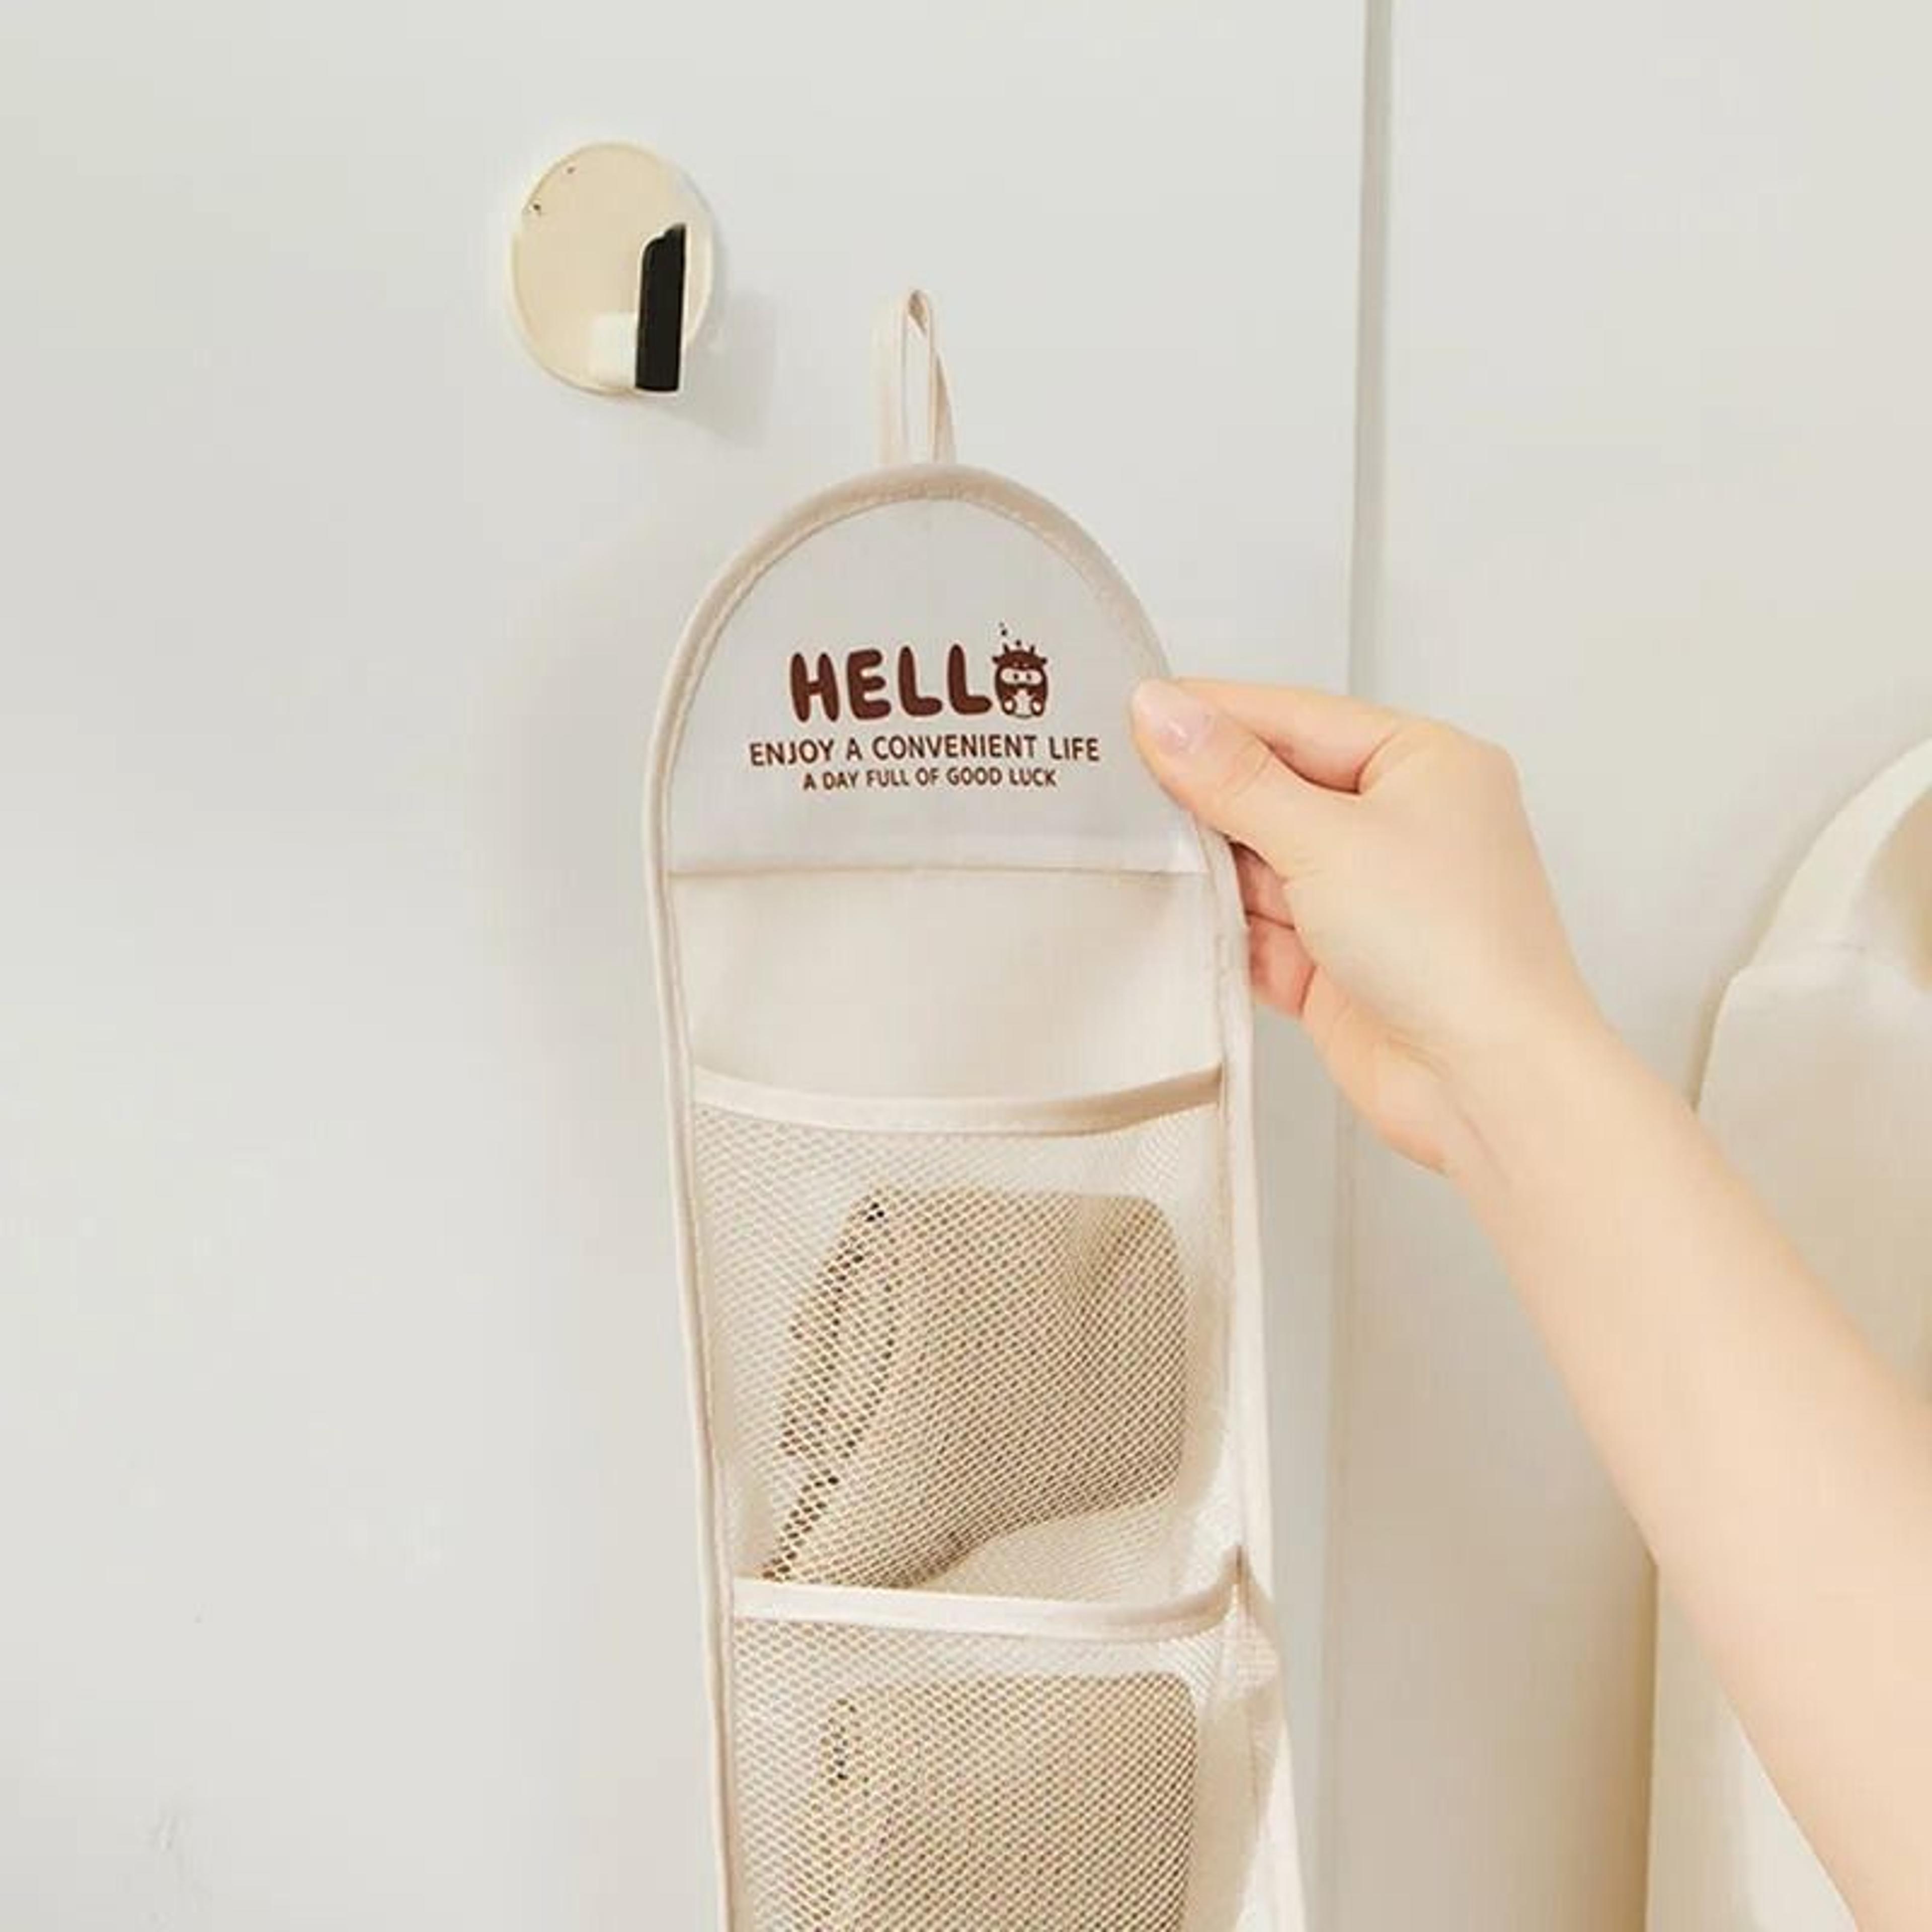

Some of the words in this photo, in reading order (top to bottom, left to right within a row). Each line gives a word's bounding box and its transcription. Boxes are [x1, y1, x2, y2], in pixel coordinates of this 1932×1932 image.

[749, 738, 835, 767] ENJOY
[846, 737, 863, 761] A
[871, 734, 1038, 761] CONVENIENT
[1048, 736, 1101, 762] LIFE
[802, 772, 817, 791] A
[822, 771, 859, 791] DAY
[865, 769, 910, 787] FULL
[914, 766, 940, 787] OF
[945, 766, 1003, 786] GOOD
[1008, 767, 1057, 788] LUCK
